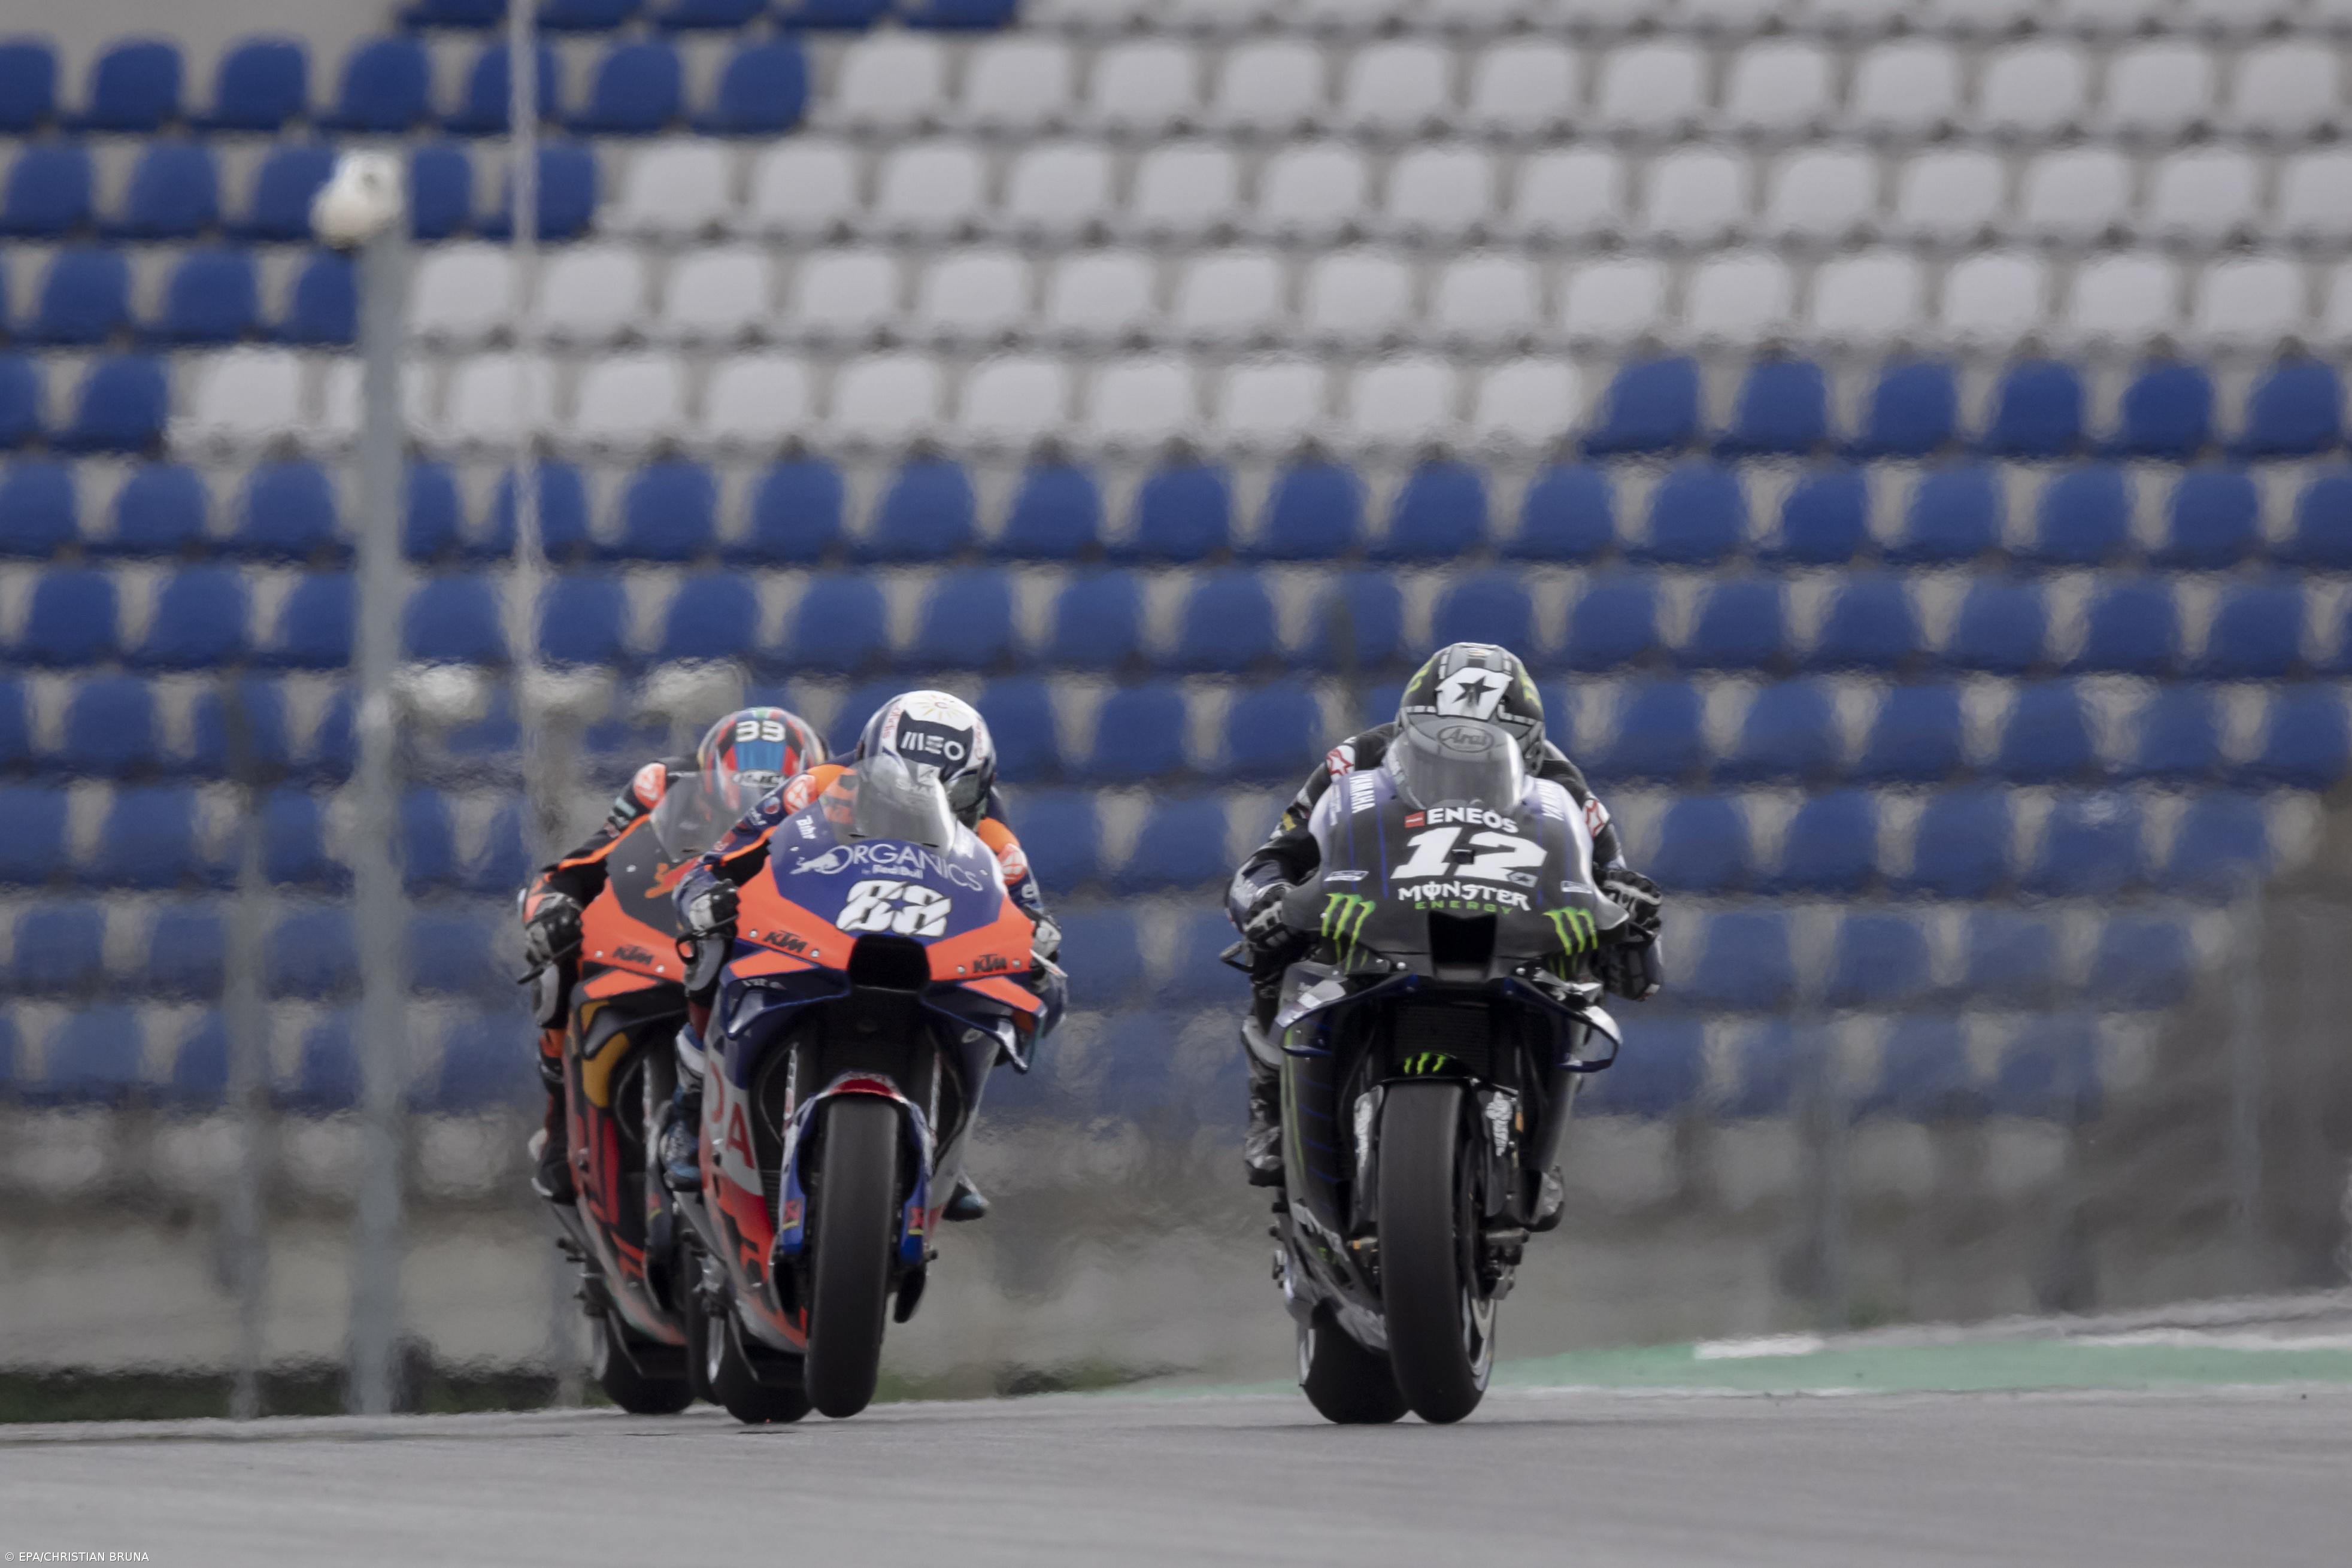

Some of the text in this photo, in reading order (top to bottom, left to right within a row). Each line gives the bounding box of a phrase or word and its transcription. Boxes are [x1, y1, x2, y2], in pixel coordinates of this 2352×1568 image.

[736, 720, 786, 742] 33
[1439, 728, 1486, 745] Arai
[901, 731, 965, 761] MEO
[1349, 773, 1375, 814] YAMAHA
[1426, 807, 1519, 833] ENEOS
[815, 843, 983, 891] ORGANICS
[1390, 827, 1548, 881] 12
[836, 880, 951, 937] 88
[1398, 881, 1531, 911] MONSTER
[1414, 900, 1514, 914] ENERGY
[762, 930, 807, 953] KTM
[613, 944, 654, 966] KTM
[973, 954, 1007, 973] KTM
